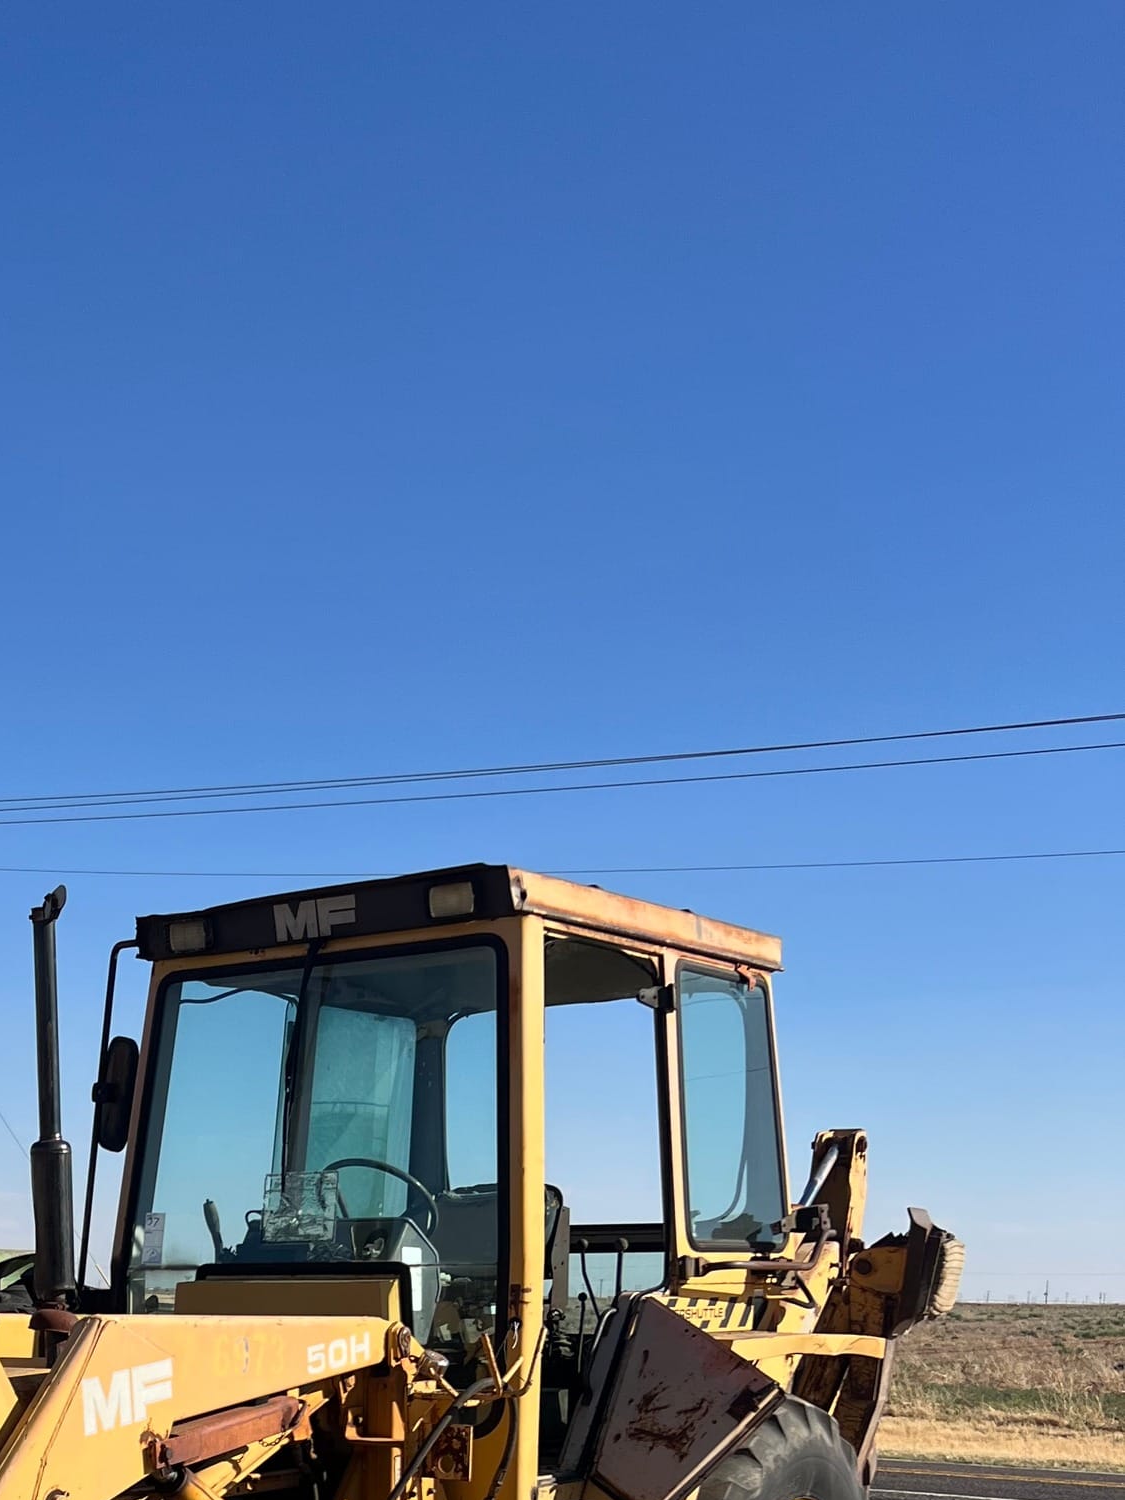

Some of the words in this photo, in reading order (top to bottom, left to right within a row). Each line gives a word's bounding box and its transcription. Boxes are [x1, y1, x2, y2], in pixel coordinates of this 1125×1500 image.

[273, 894, 356, 942] MF
[306, 1331, 371, 1374] 50H
[82, 1358, 173, 1436] MF
